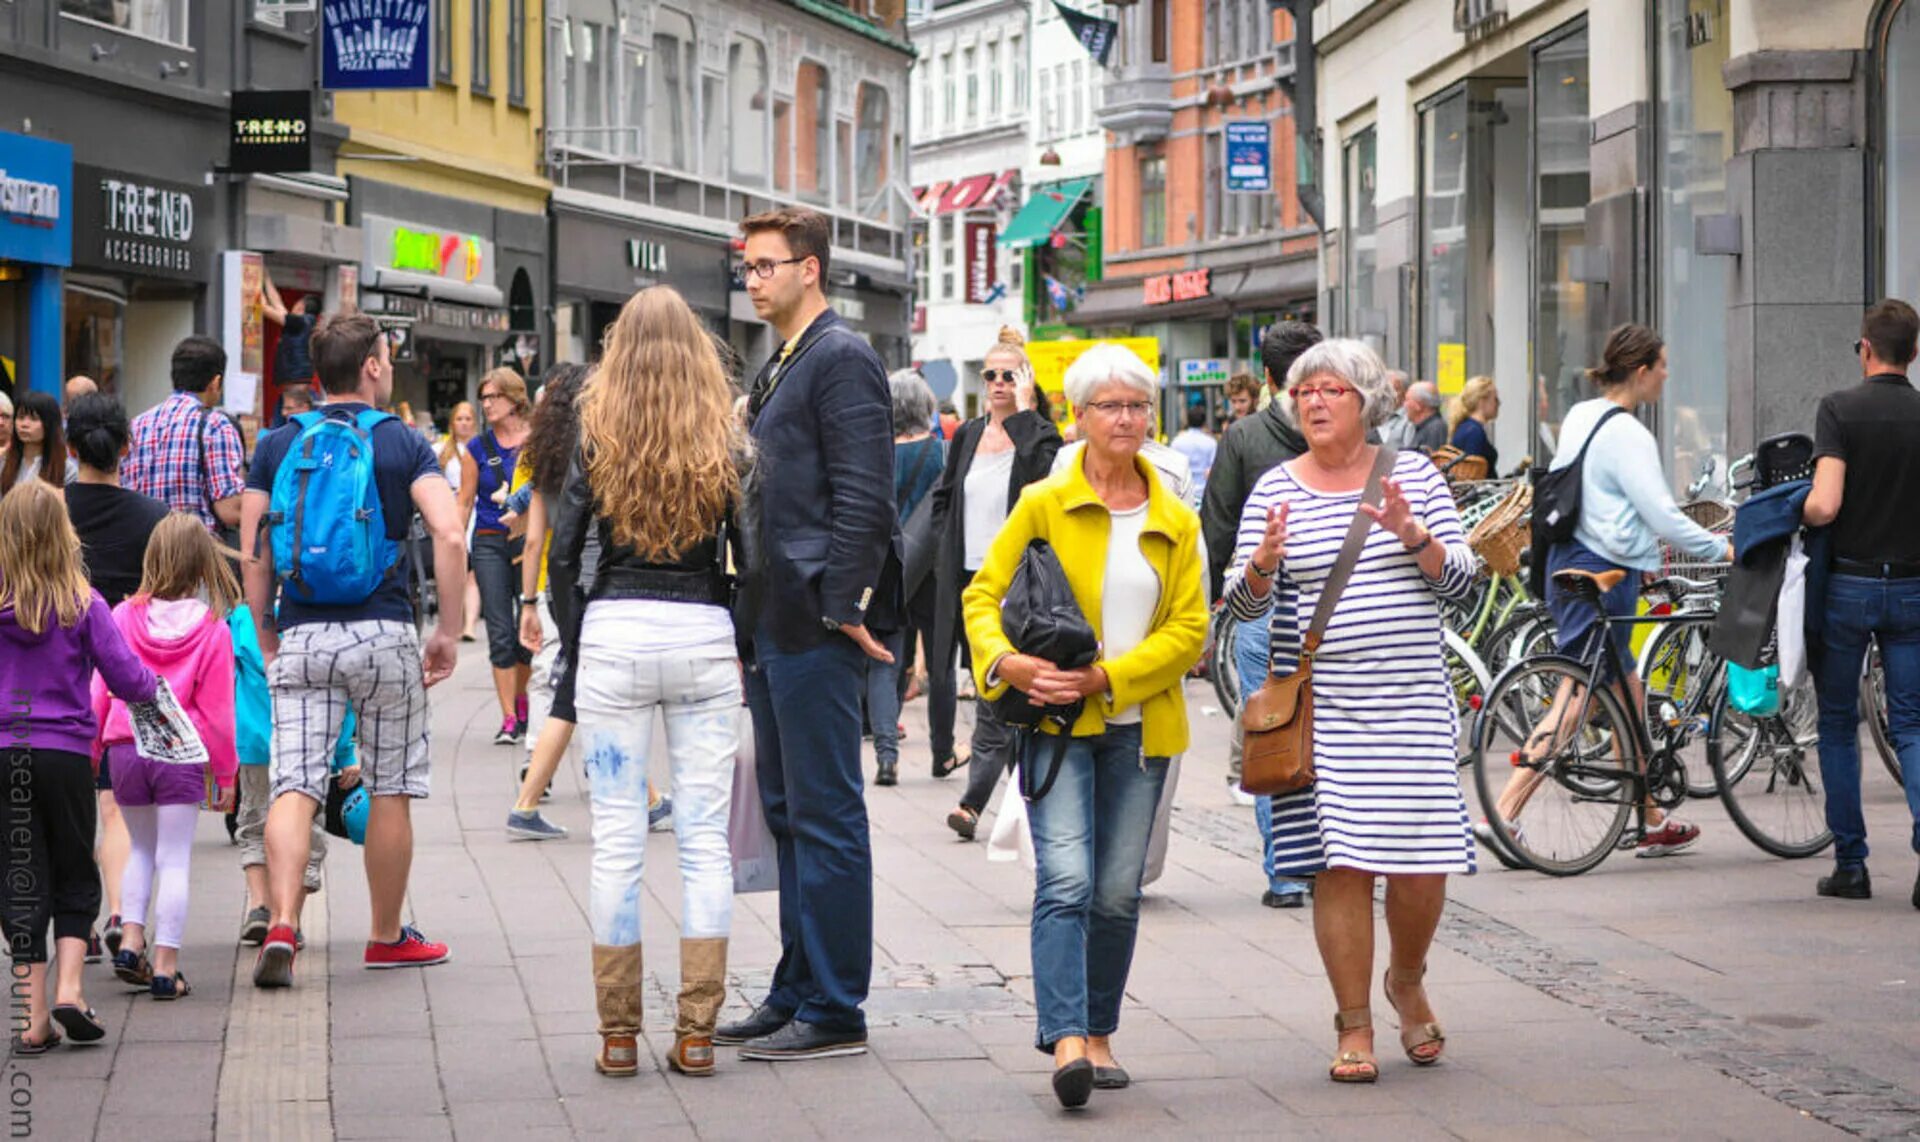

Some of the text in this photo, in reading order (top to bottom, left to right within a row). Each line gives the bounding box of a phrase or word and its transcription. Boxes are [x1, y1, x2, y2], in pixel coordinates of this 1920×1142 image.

[324, 0, 426, 27] MANHATTAN
[235, 119, 306, 135] TREND
[101, 179, 193, 242] TREND
[104, 239, 190, 270] ACCESSORIES
[628, 238, 668, 273] VILA
